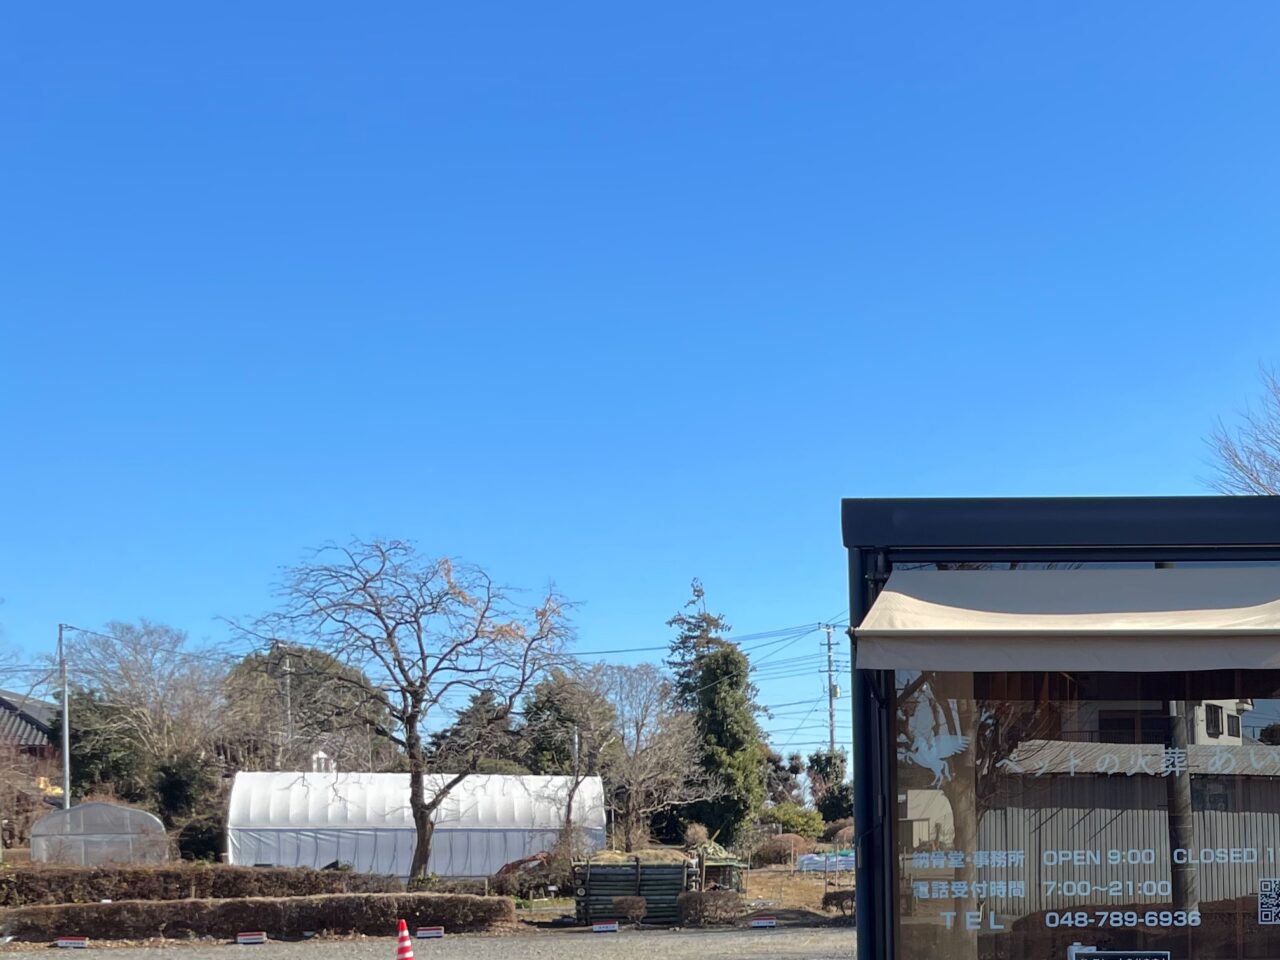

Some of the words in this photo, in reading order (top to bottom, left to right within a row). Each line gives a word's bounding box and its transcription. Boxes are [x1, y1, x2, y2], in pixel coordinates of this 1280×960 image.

[996, 746, 1188, 777] ペットの火葬
[1043, 850, 1100, 866] OPEN
[1107, 848, 1155, 865] 9:00
[1173, 848, 1258, 865] CLOSED
[911, 880, 1025, 899] 電話受付時間
[939, 911, 1005, 930] TEL
[1045, 911, 1202, 928] 048-789-6936
